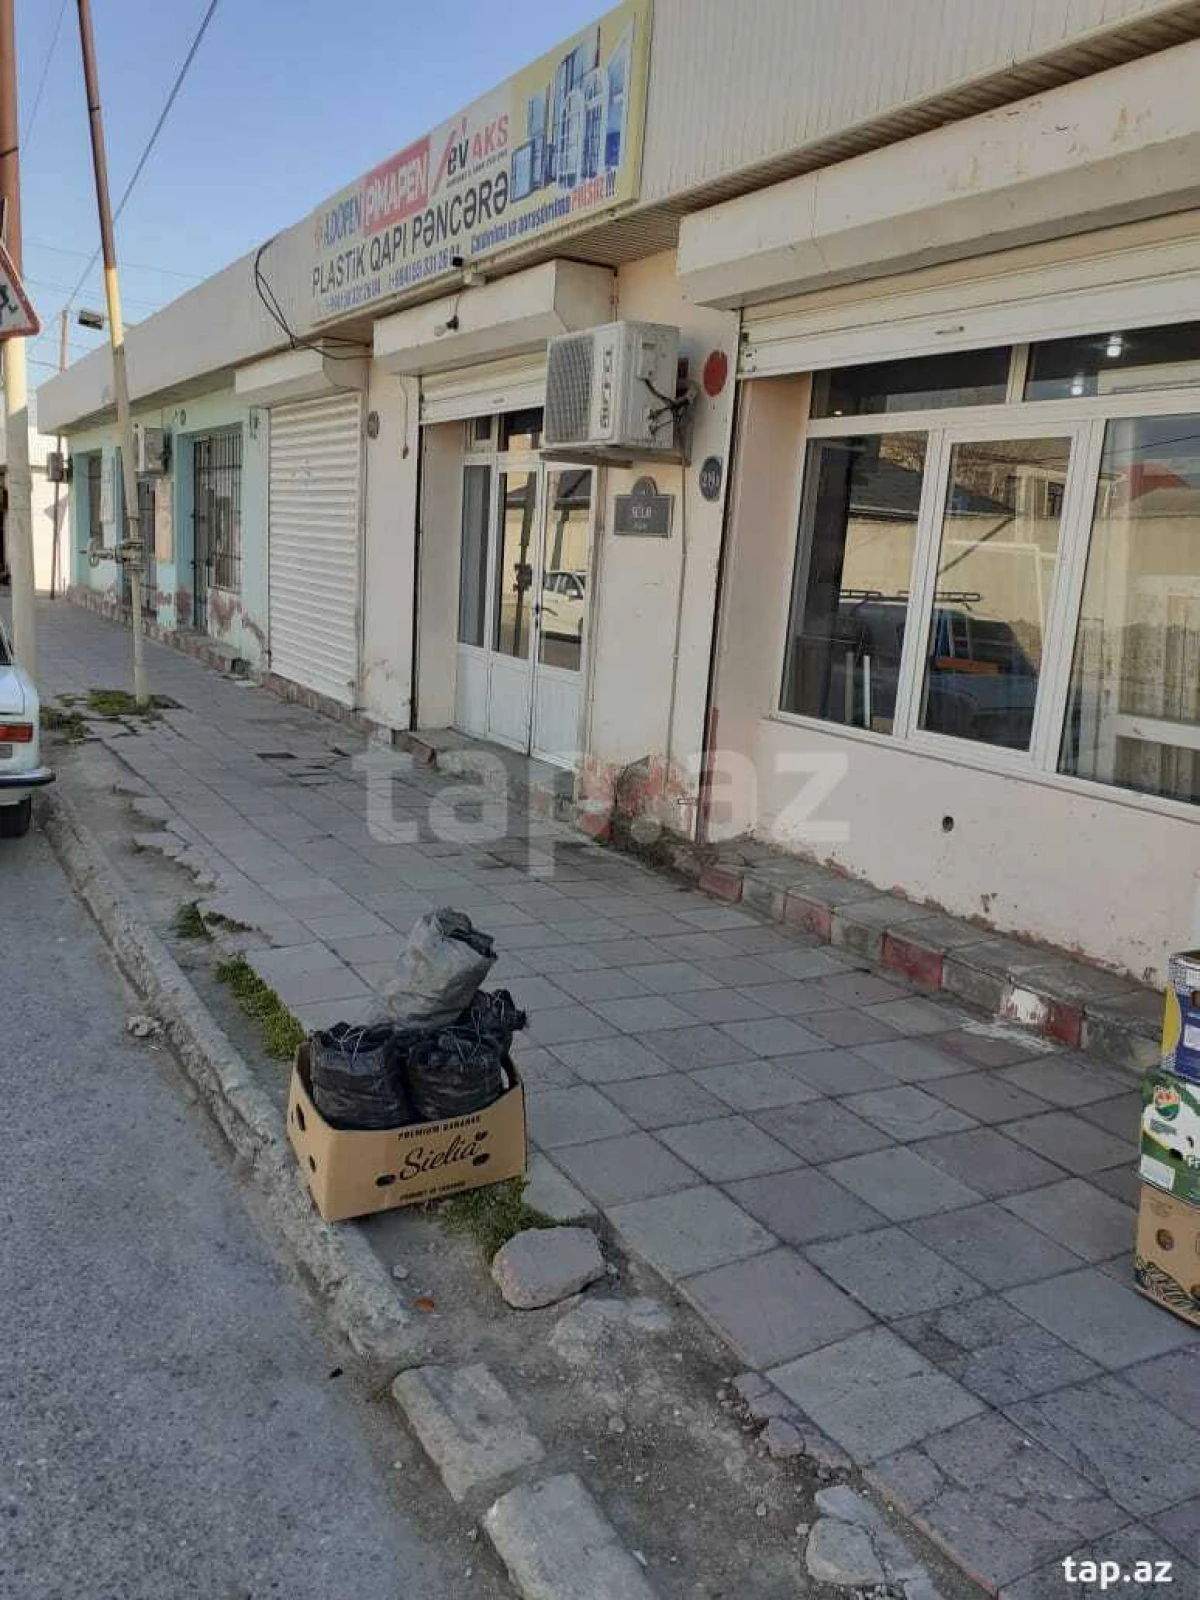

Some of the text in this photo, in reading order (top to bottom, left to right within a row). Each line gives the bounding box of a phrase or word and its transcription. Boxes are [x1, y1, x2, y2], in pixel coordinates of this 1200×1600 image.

[370, 217, 408, 273] QAPI
[412, 170, 509, 255] PƏNCƏRƏ
[398, 1125, 440, 1141] PREMIUM
